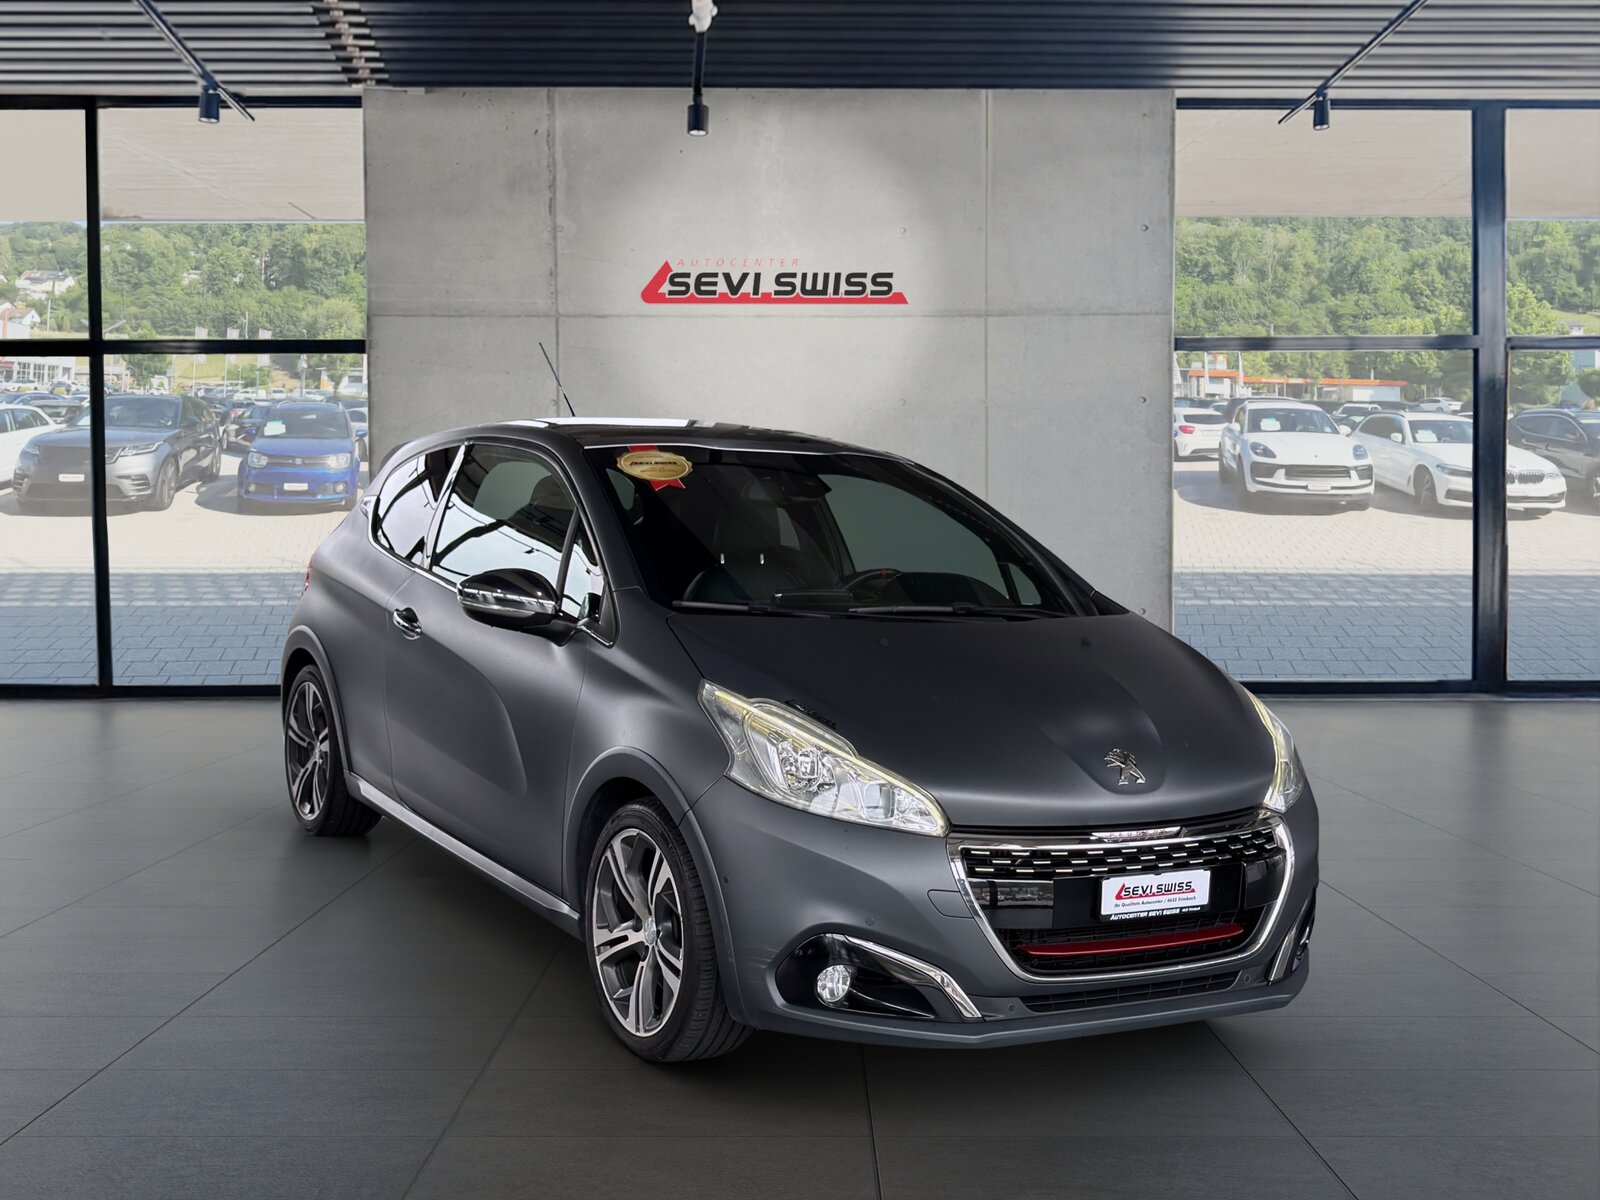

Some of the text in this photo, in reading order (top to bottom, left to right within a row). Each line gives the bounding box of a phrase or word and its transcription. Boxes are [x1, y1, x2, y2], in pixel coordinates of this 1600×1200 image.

[677, 258, 800, 267] AUTOCENTER
[667, 272, 894, 296] SEVI SWISS
[1123, 881, 1192, 896] SEVI SWISS
[1163, 908, 1180, 916] SWISS
